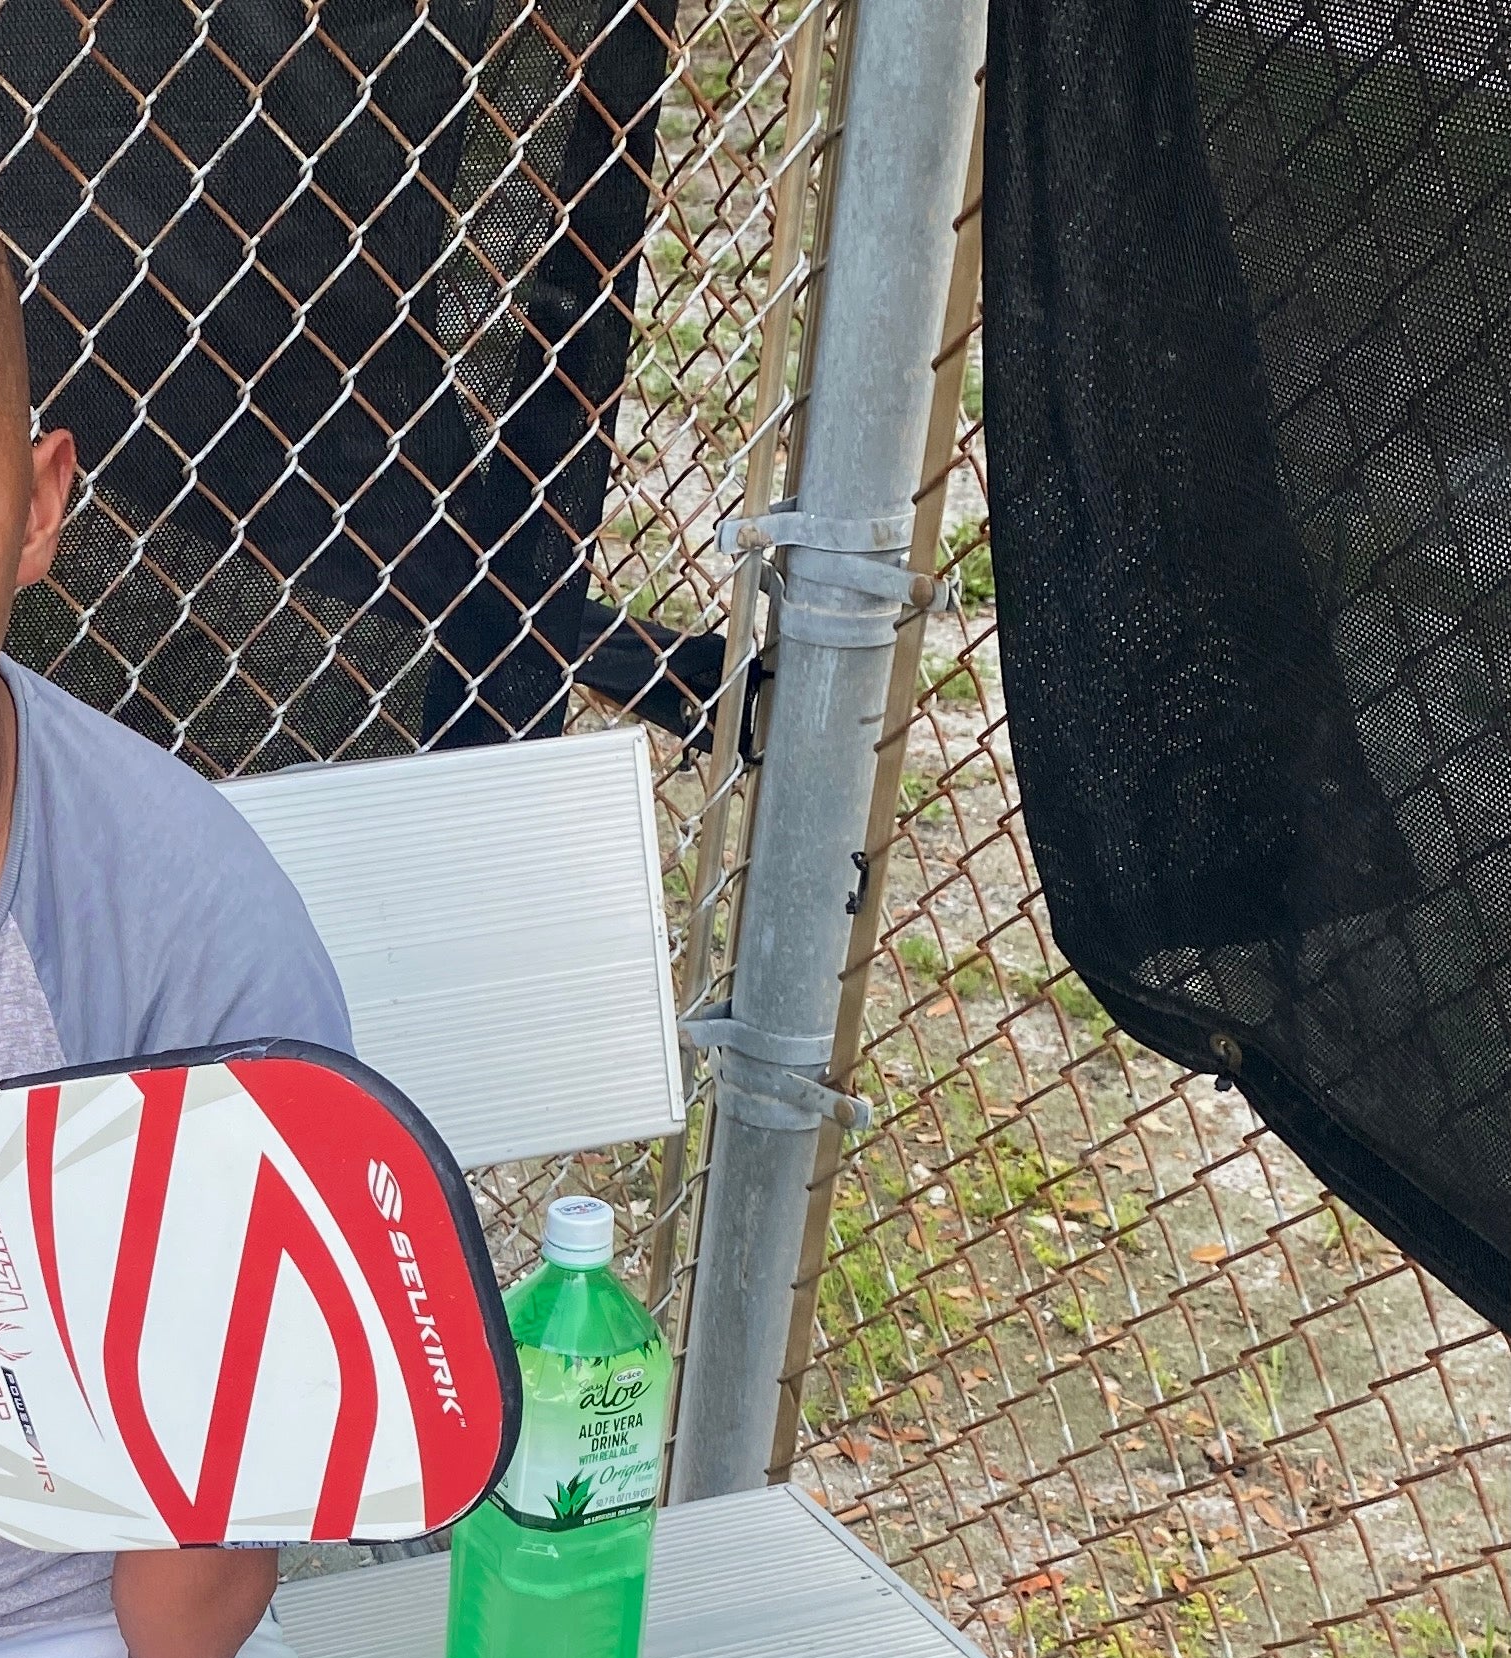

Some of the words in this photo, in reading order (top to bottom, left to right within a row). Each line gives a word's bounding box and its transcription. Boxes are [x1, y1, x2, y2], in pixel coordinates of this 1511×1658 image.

[388, 1229, 464, 1416] SELKIRK
[4, 1372, 35, 1435] POWER
[579, 1368, 653, 1409] aloe
[578, 1419, 611, 1440] ALOE
[613, 1412, 643, 1433] VERA
[591, 1430, 629, 1453] DRINK
[578, 1453, 599, 1466] WITH
[599, 1448, 618, 1461] REAL
[619, 1443, 639, 1457] ALOE
[599, 1456, 659, 1492] Origina
